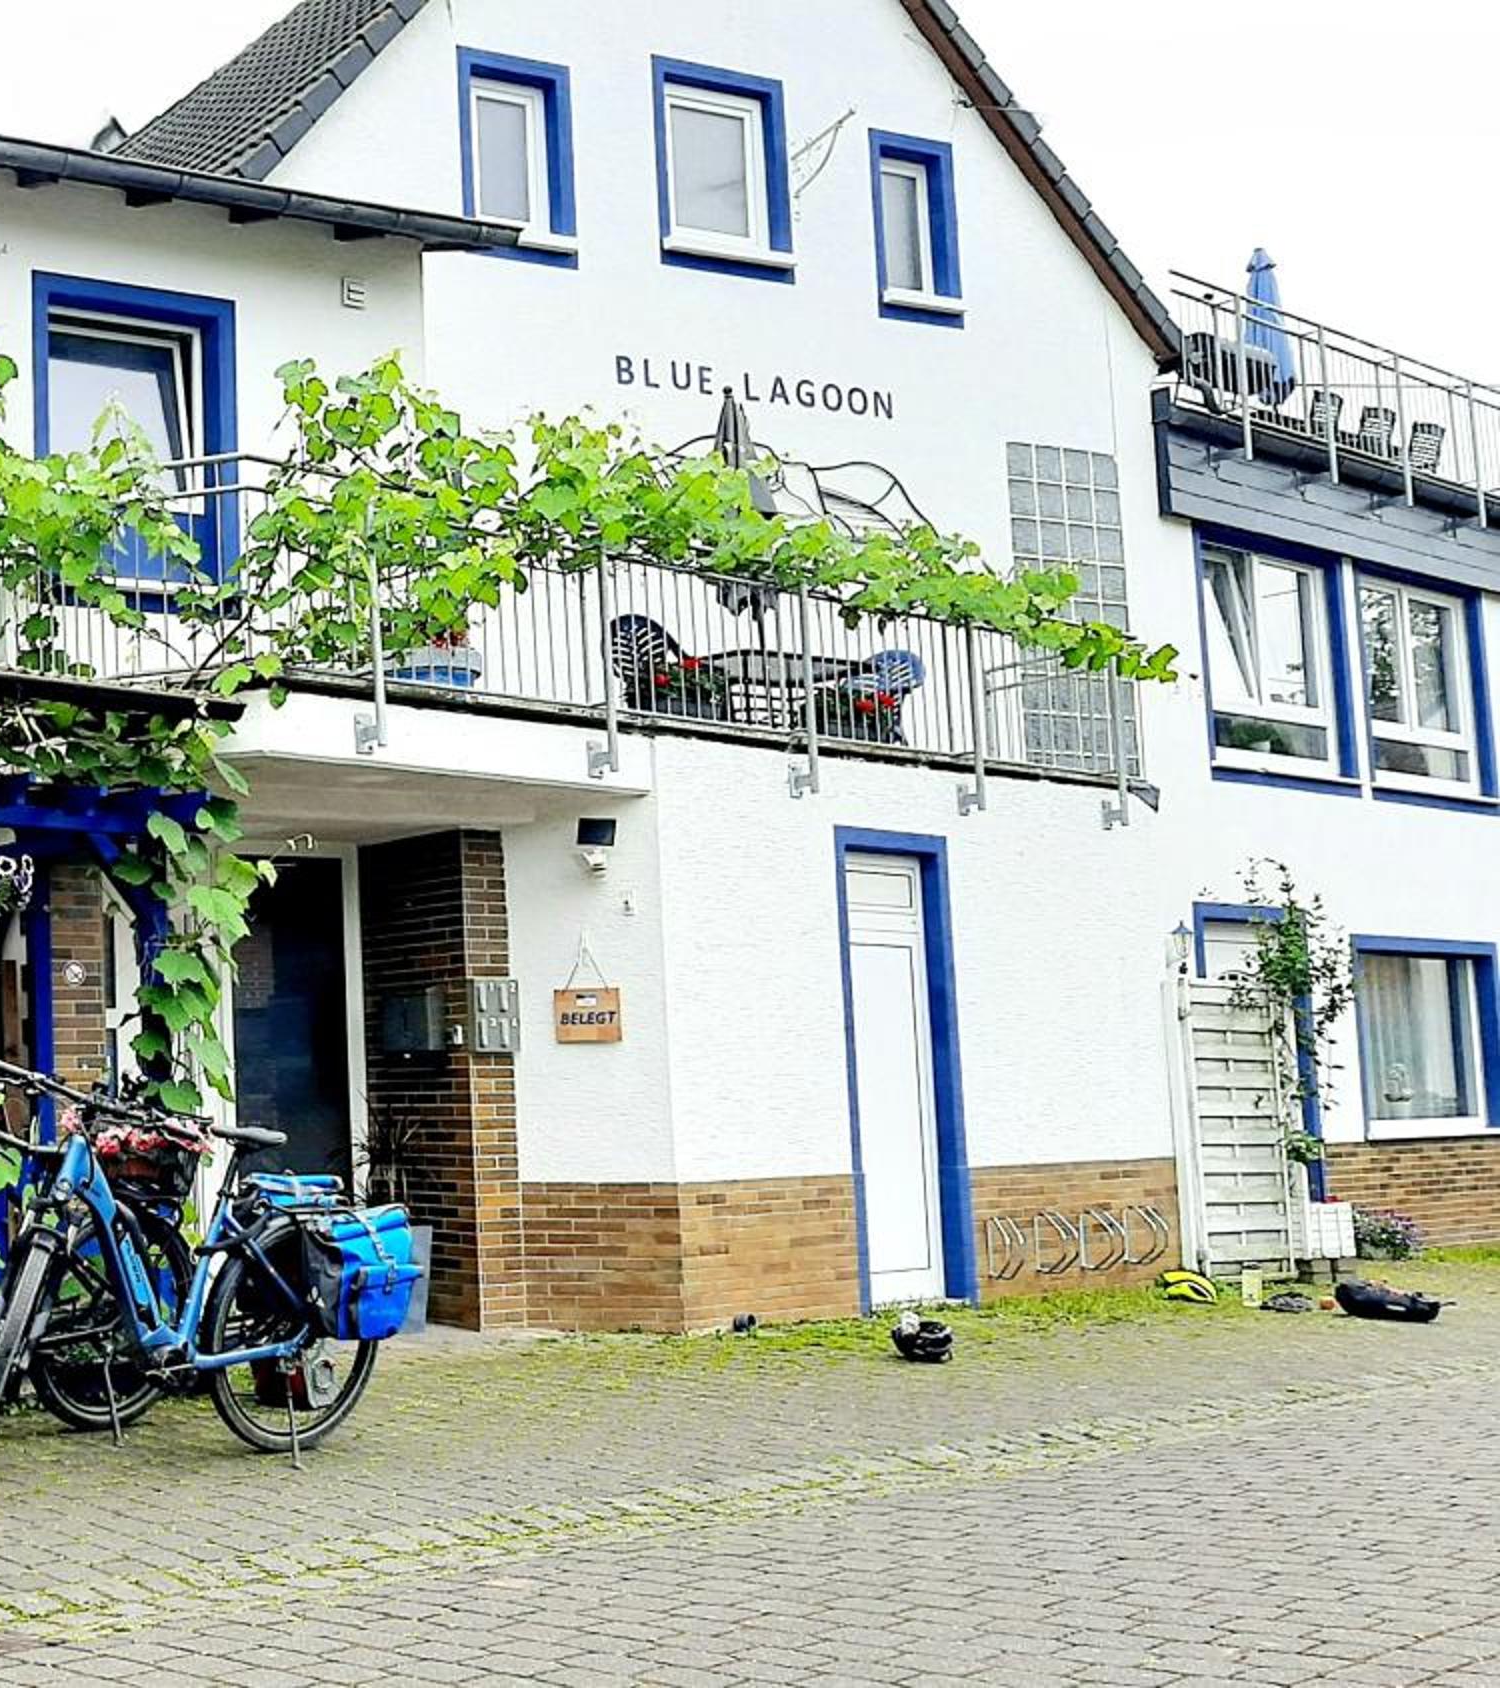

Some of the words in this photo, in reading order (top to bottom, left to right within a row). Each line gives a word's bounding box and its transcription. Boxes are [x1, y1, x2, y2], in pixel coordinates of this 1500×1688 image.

[615, 354, 713, 395] BLUE
[743, 372, 894, 420] LAGOON
[560, 1011, 617, 1025] BELEGT
